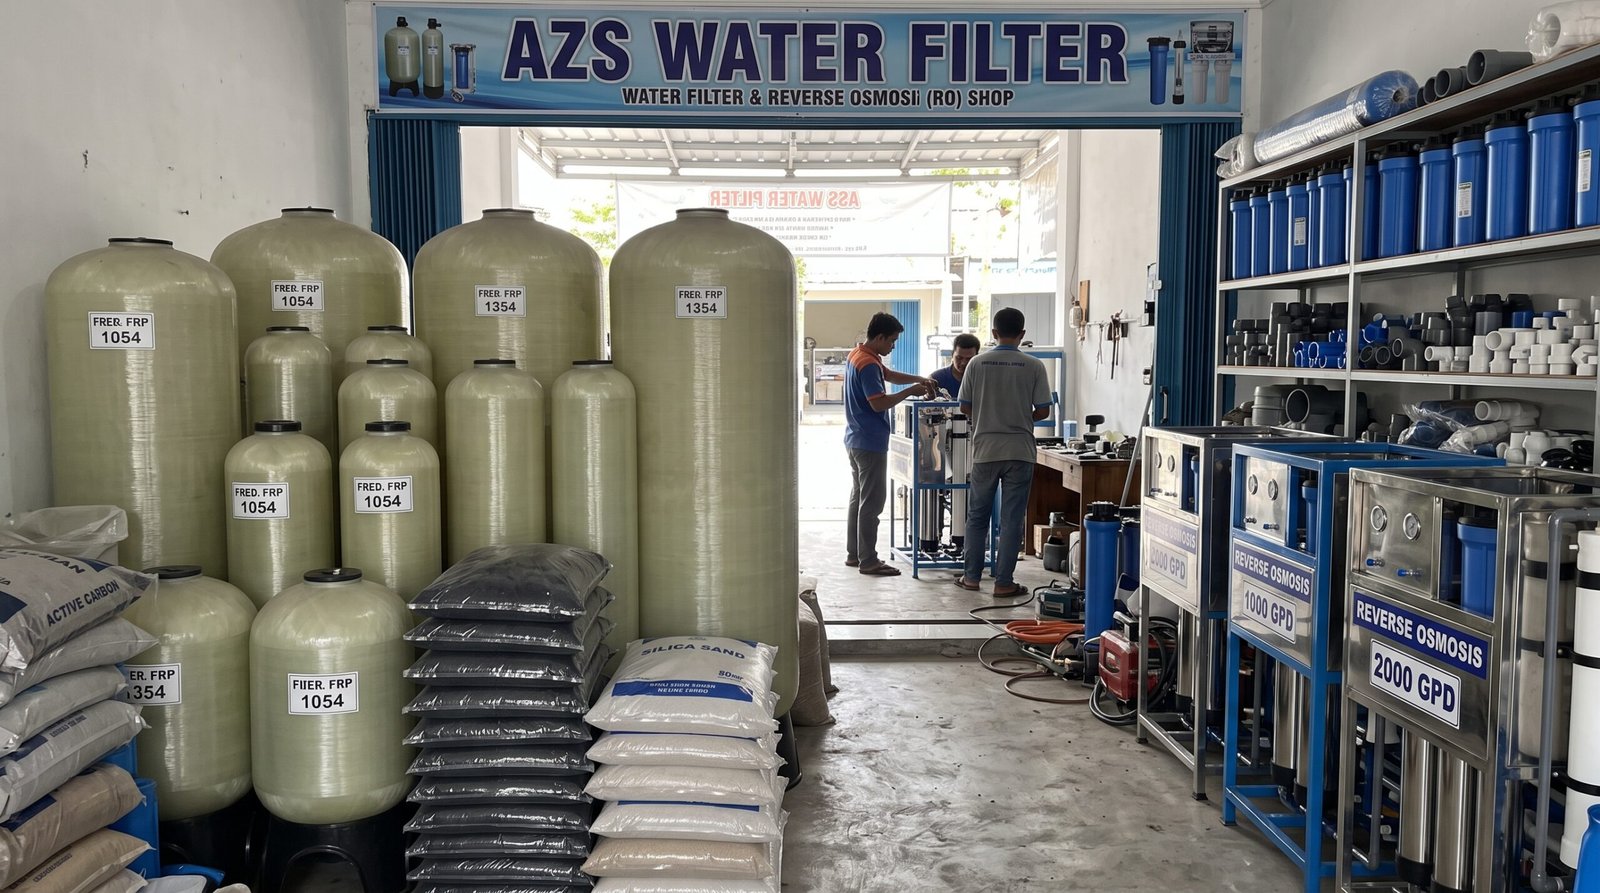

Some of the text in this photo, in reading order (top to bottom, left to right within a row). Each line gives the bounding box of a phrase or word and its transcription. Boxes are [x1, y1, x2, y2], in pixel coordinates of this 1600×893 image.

[503, 19, 1127, 83] AZS WATER FILTER
[622, 88, 681, 105] WATER
[687, 88, 743, 105] FILTER
[750, 89, 761, 105] &
[768, 89, 844, 106] REVERSE
[927, 90, 961, 109] (RO)
[968, 90, 1013, 106] SHOP
[301, 284, 319, 292] FRP
[504, 289, 522, 298] FRP
[705, 290, 723, 299] FRP
[282, 296, 314, 307] 1054
[485, 301, 516, 312] 1354
[686, 302, 717, 313] 1354
[126, 317, 149, 327] FRP
[101, 331, 141, 344] 1054
[235, 487, 283, 497] FRED. FRP
[357, 481, 407, 491] FRED. FRP
[241, 501, 276, 513] 1054
[364, 494, 401, 508] 1054
[1169, 556, 1186, 579] GPD
[1234, 550, 1310, 596] REVERSE OSMOSIS
[47, 580, 120, 627] ACTIVE CARBON
[1244, 590, 1293, 632] 1000 GPD
[1356, 600, 1483, 669] REVERSE OSMOSIS
[641, 644, 745, 659] SILICA SAND
[130, 669, 176, 681] ER. FRP
[329, 678, 353, 690] FRP
[1373, 652, 1456, 713] 2000 GPD
[301, 693, 344, 709] 1054
